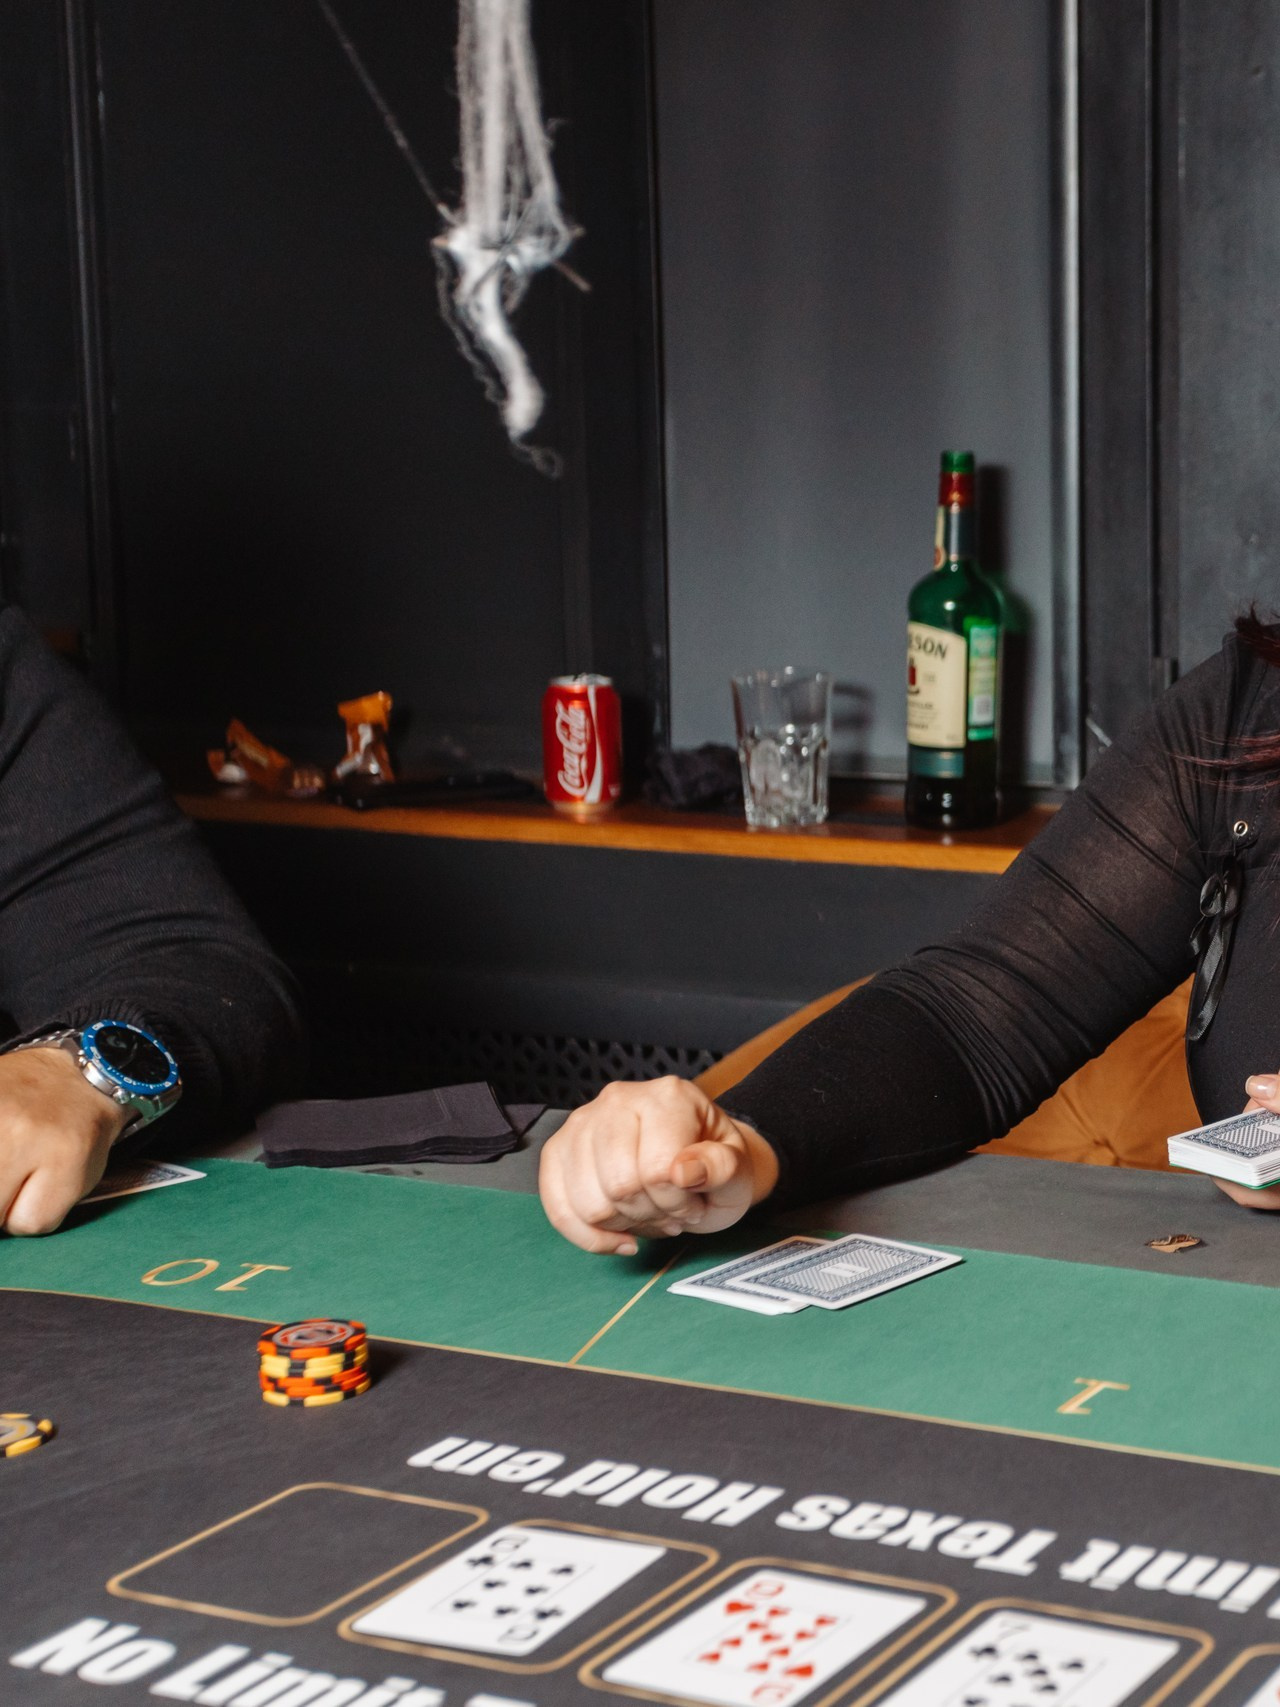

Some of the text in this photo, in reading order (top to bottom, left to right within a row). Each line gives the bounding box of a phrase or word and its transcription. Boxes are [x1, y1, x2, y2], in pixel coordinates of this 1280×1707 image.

[141, 1258, 292, 1291] 10
[1056, 1377, 1130, 1415] 1
[406, 1436, 785, 1527] Hold'em
[775, 1495, 1058, 1577] Texas
[8, 1616, 177, 1685] No
